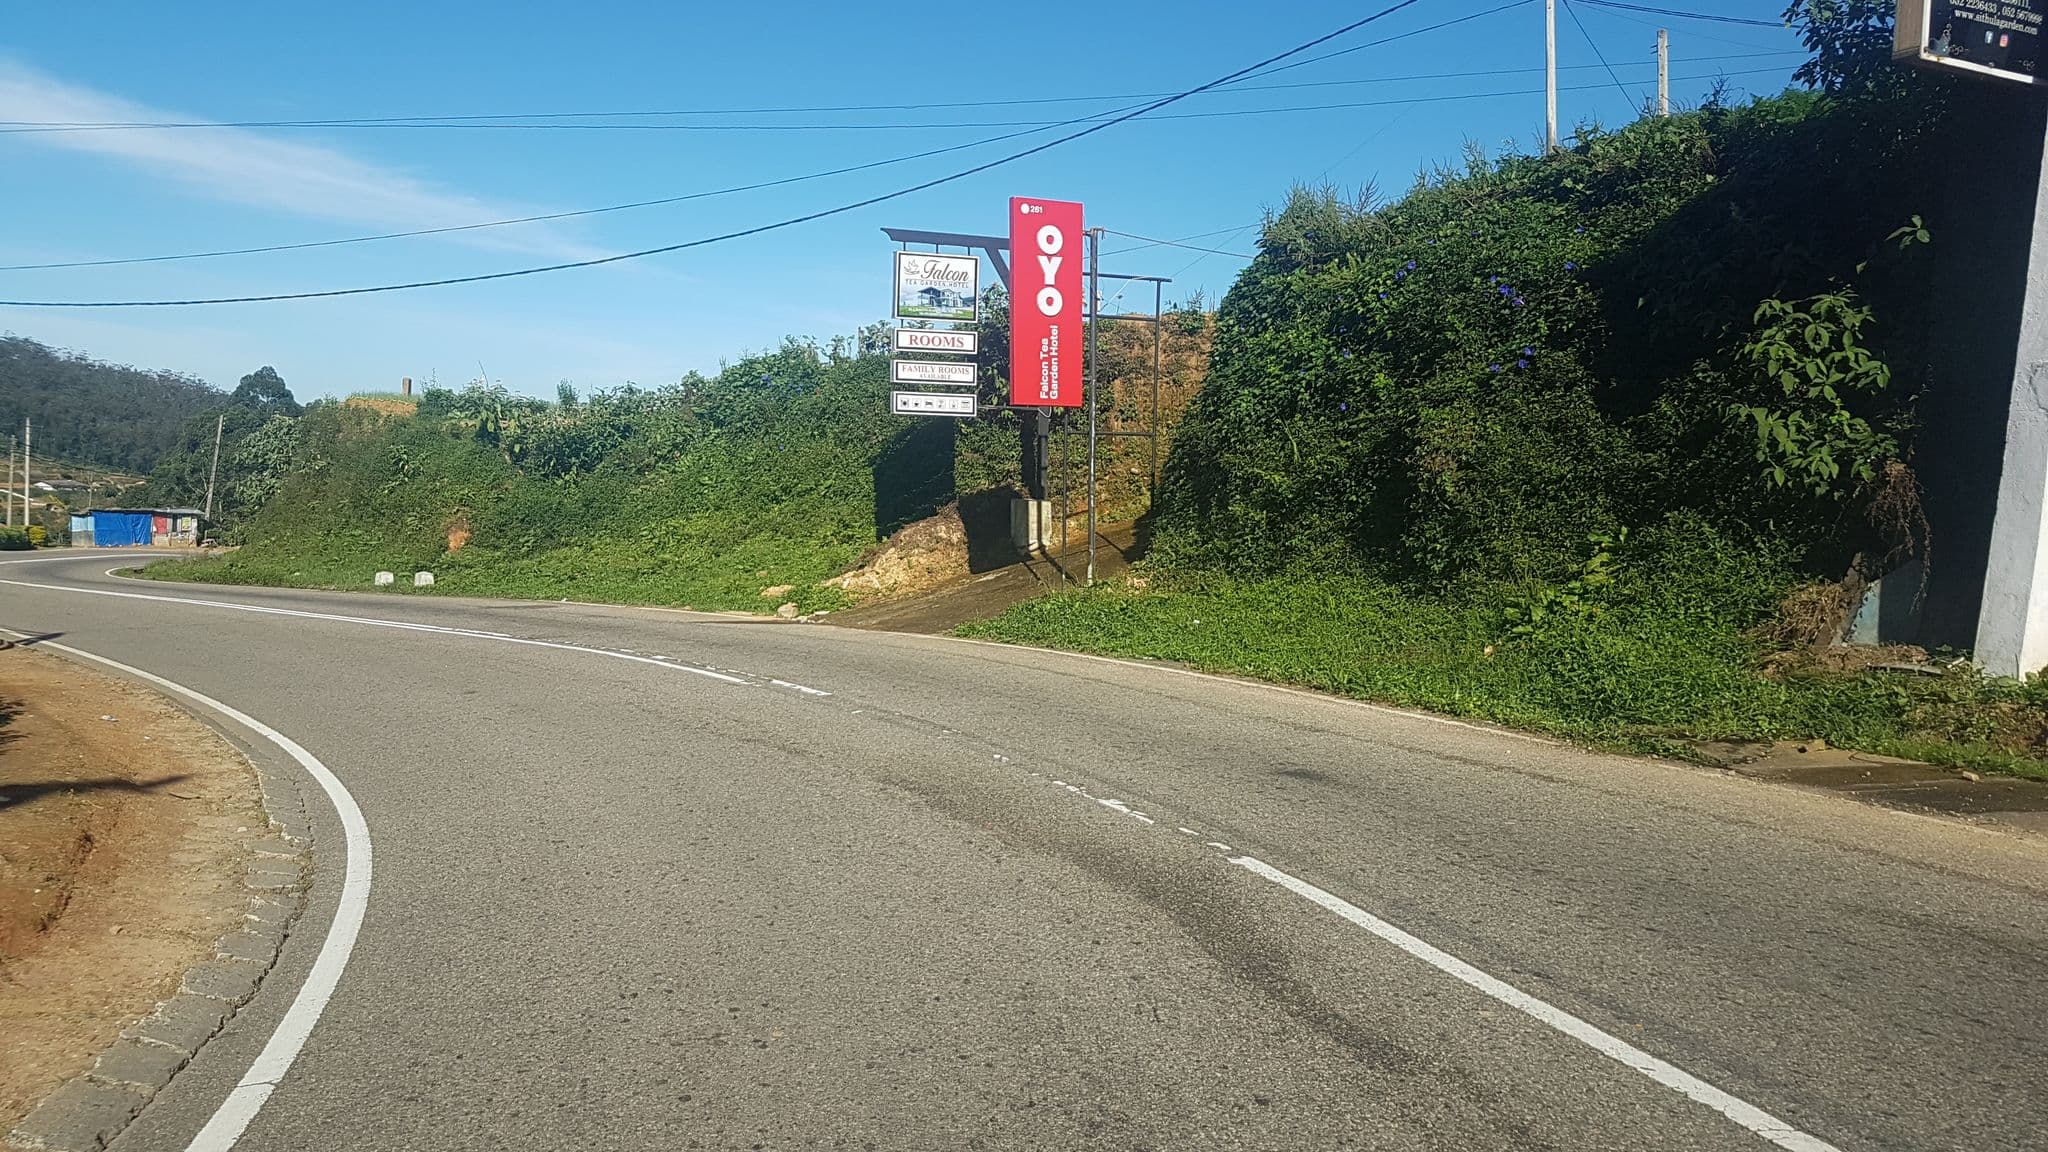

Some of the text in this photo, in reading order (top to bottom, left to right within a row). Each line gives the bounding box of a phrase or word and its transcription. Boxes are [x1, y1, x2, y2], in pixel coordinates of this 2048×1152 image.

[2002, 6, 2015, 17] 052
[920, 259, 969, 282] Falcon
[1037, 225, 1063, 316] OYO
[948, 281, 969, 289] HOTEL
[909, 334, 965, 348] ROOMS
[902, 365, 970, 375] FAMILY ROOMS
[1040, 338, 1049, 399] Falcon Tea
[1050, 325, 1059, 400] Garden Hotel
